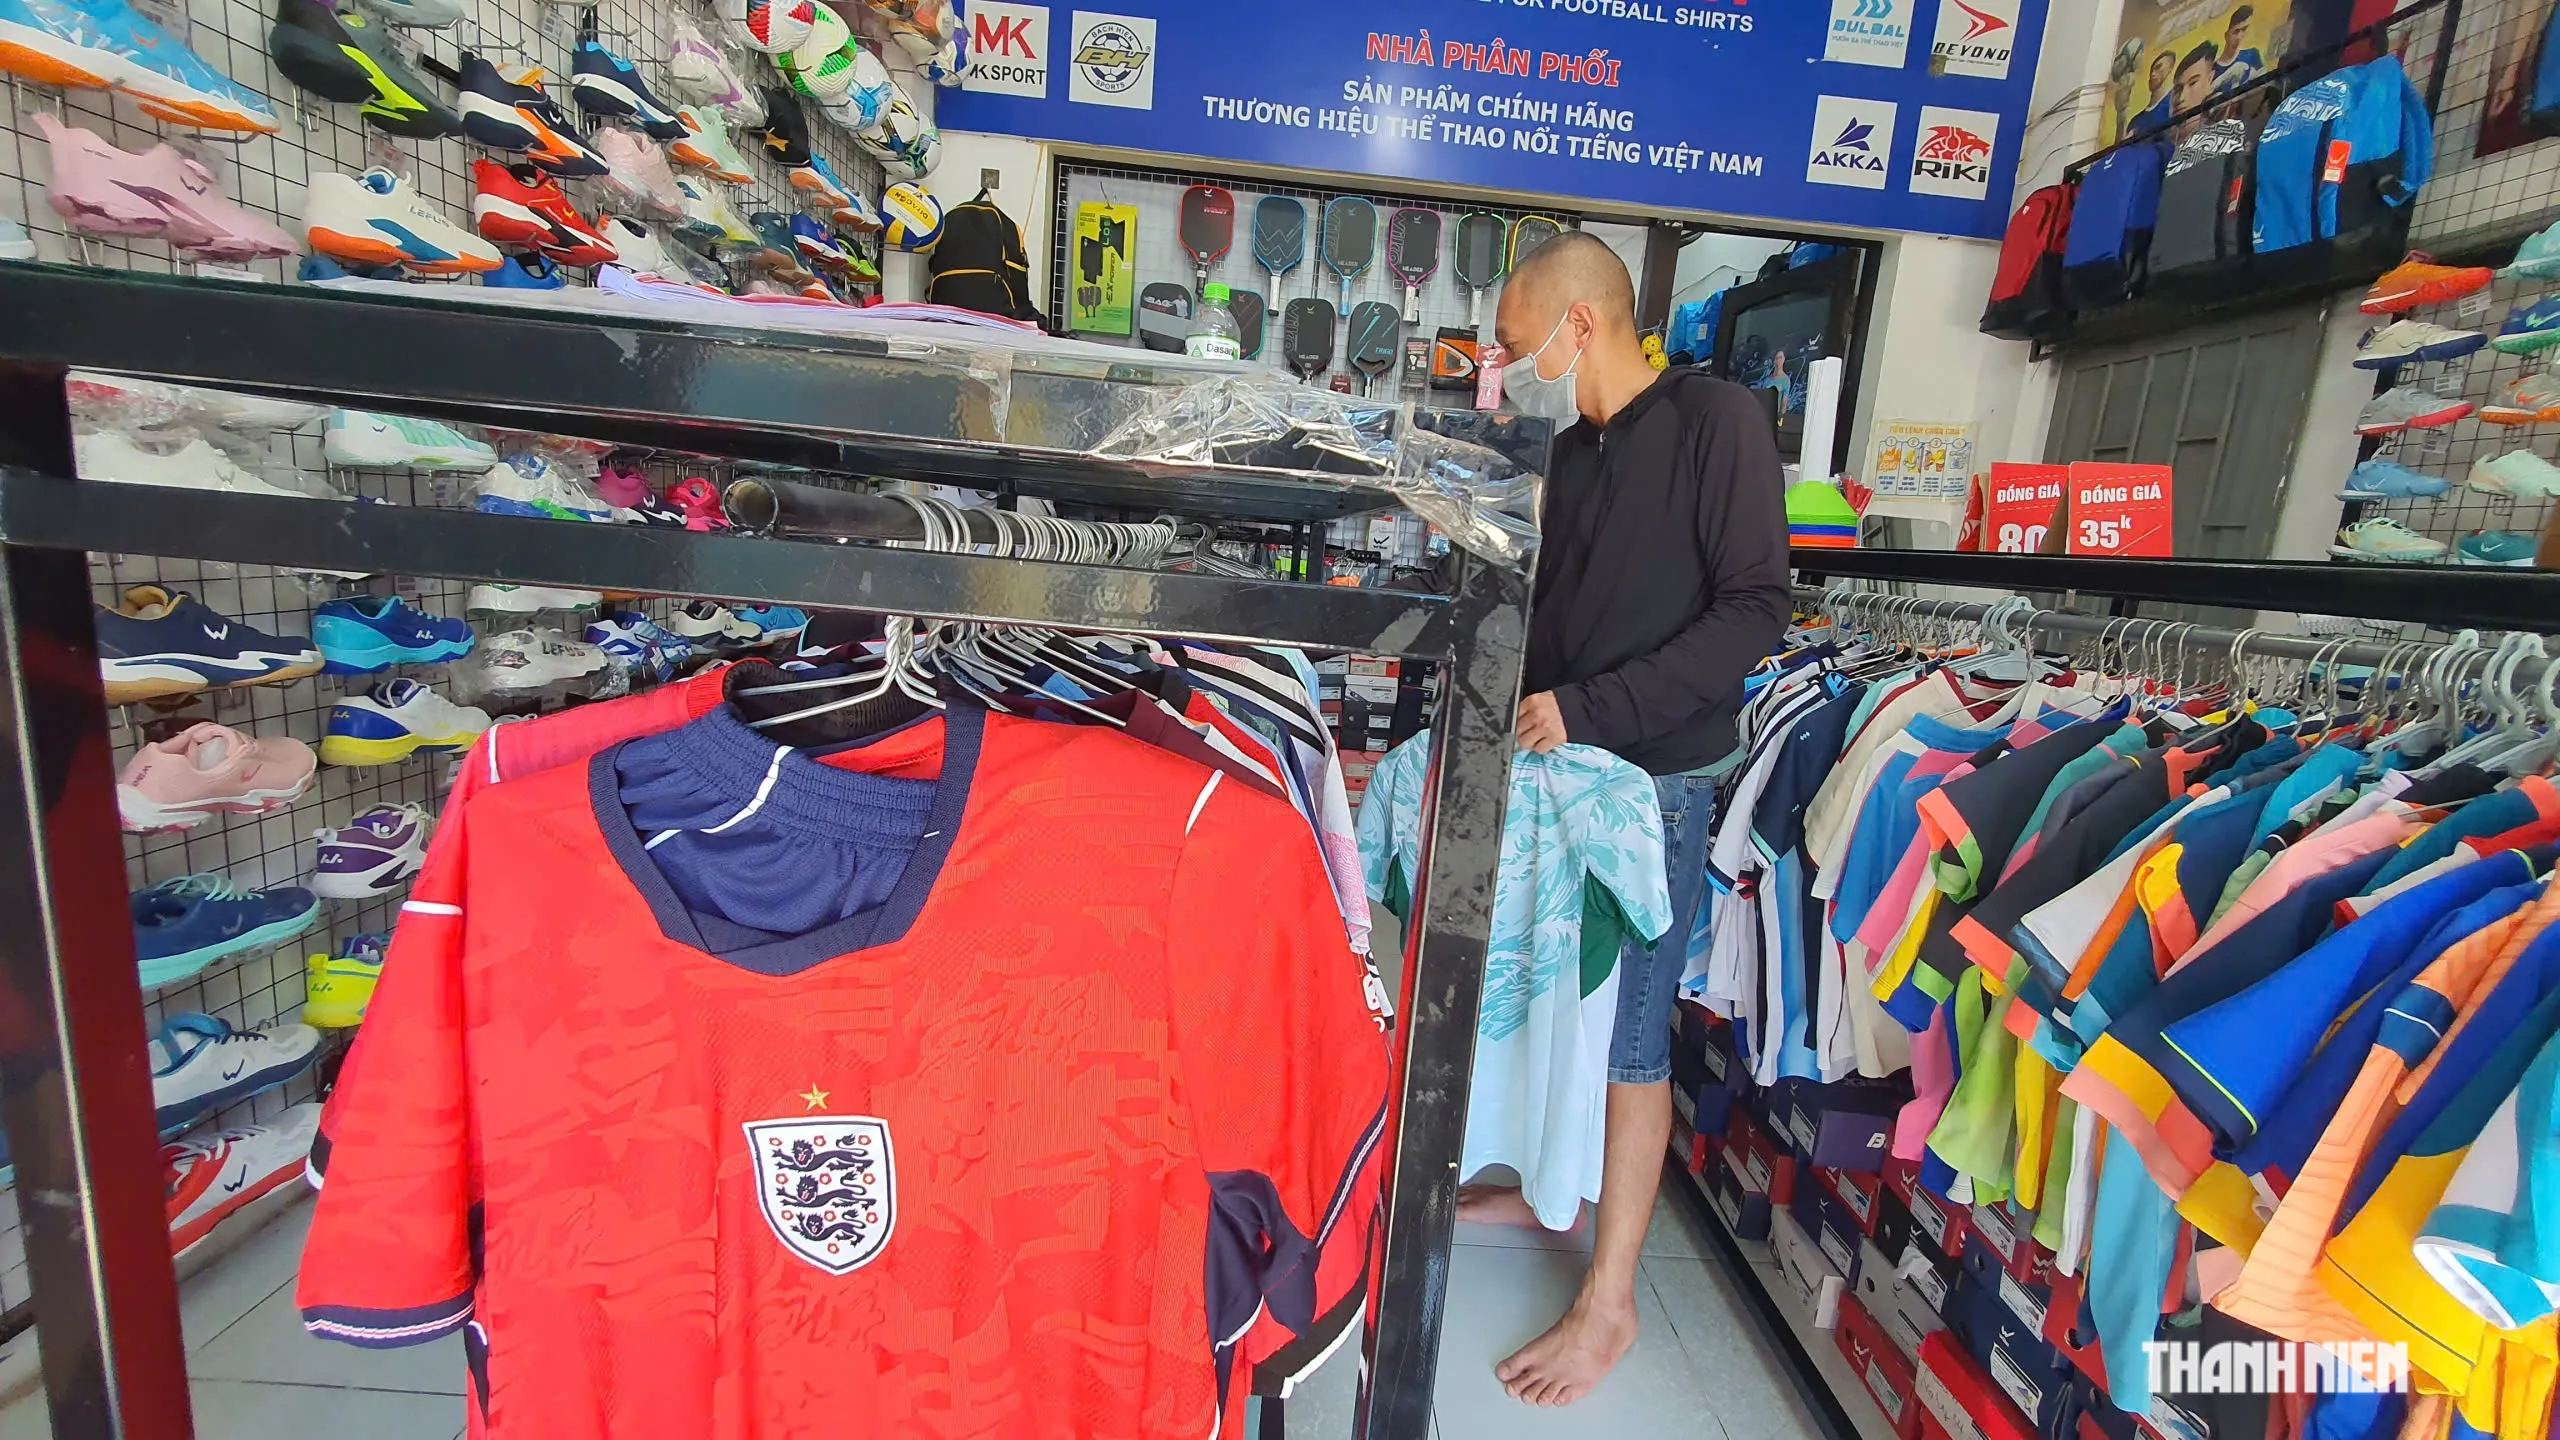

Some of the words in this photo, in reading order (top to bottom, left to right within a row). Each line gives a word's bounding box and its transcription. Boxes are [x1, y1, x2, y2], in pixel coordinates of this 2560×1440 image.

[1674, 8, 1753, 32] SHIRTS
[1833, 19, 1905, 38] BULBAL
[974, 13, 1038, 59] MK
[1073, 46, 1151, 70] BH
[1366, 29, 1434, 68] NHÀ
[1443, 37, 1530, 77] PHÂN
[1539, 48, 1621, 87] PHỐI
[1933, 42, 2010, 61] BEYOND
[990, 65, 1046, 85] SPORT
[1343, 75, 1392, 105] SẢN
[1401, 84, 1470, 114] PHẨM
[1477, 92, 1557, 123] CHÍNH
[1565, 101, 1634, 132] HÃNG
[1202, 95, 1310, 128] THƯƠNG
[1318, 106, 1378, 137] HIỆU
[1386, 113, 1436, 141] THỂ
[1440, 122, 1506, 149] THAO
[1513, 125, 1560, 155] NỔI
[1567, 132, 1641, 164] TIẾNG
[1647, 141, 1704, 174] VIỆT
[1709, 151, 1763, 177] NAM
[1811, 151, 1885, 171] AKKA
[1206, 343, 1236, 357] Dasan
[2037, 481, 2061, 499] GIÁ
[2132, 481, 2162, 501] GIÁ
